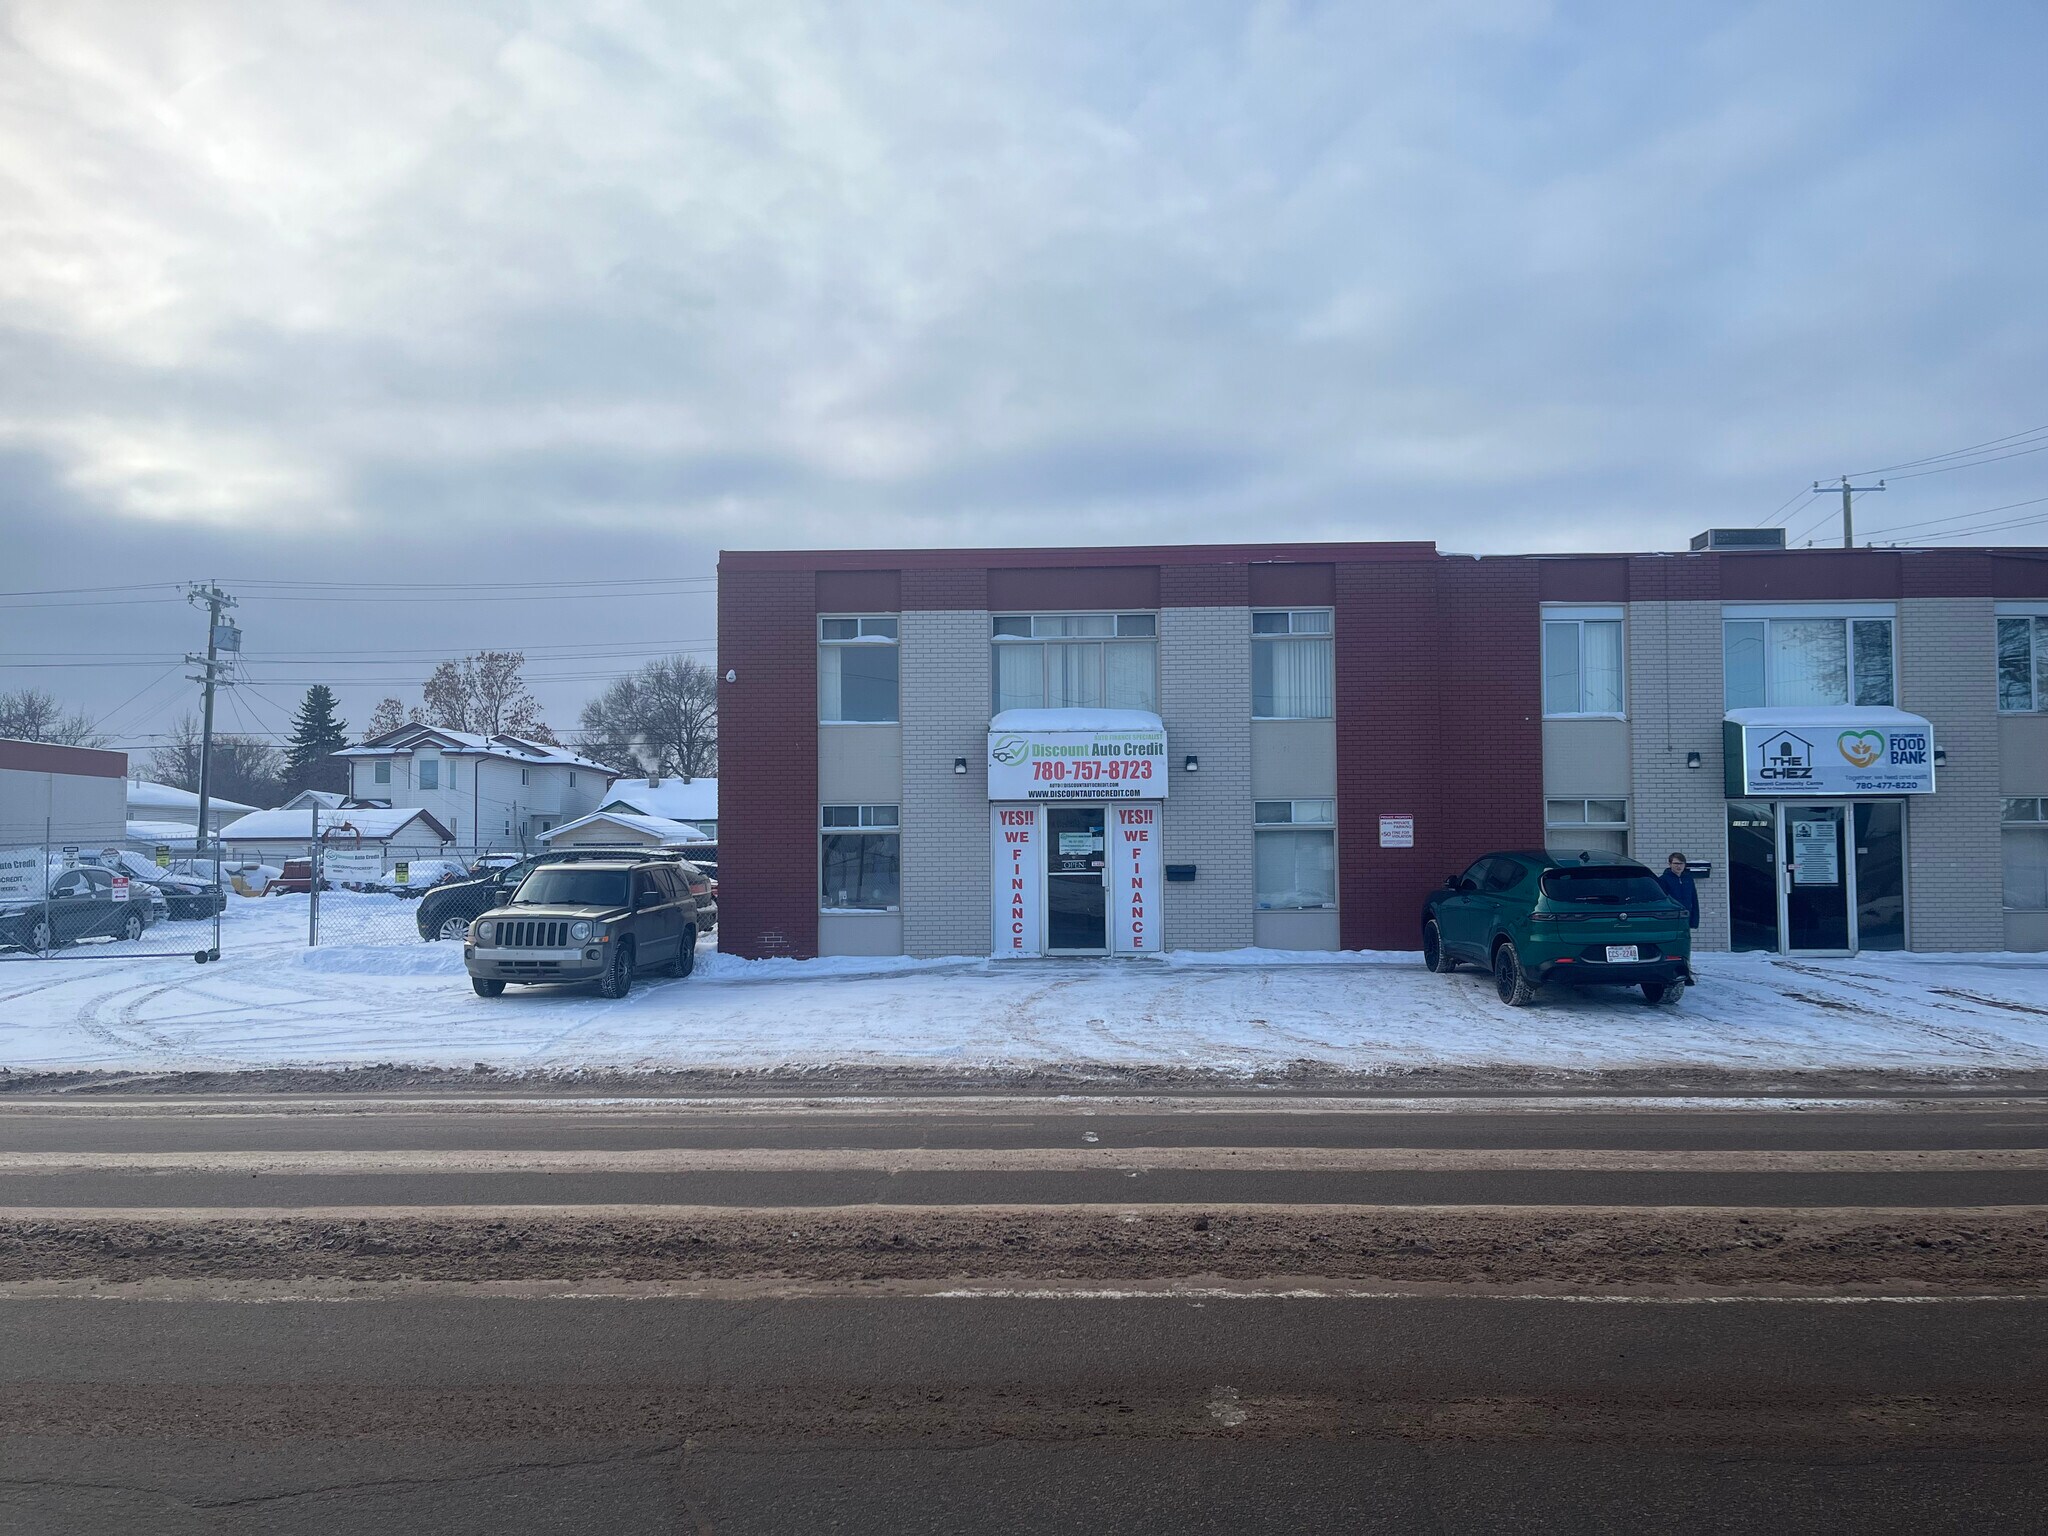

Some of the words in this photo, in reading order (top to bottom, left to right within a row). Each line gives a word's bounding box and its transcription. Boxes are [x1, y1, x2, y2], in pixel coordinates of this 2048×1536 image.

[1032, 744, 1089, 757] Discount
[1092, 743, 1120, 756] Auto
[1124, 742, 1163, 756] Credit
[1890, 738, 1925, 750] FOOD
[1770, 757, 1802, 766] THE
[1890, 751, 1926, 764] BANK
[1032, 760, 1152, 780] 780-757-8723
[1760, 767, 1813, 779] CHEZ
[1028, 789, 1140, 798] WWW.DISCOUNTAUTOCREDIT.COM
[1000, 811, 1034, 825] YES!!
[1119, 810, 1153, 824] YES!!
[1005, 832, 1029, 842] WE
[1124, 831, 1148, 841] WE
[0, 862, 12, 870] uto
[13, 860, 36, 869] Credit
[1012, 849, 1023, 948] FINANCE
[1132, 848, 1143, 948] FINANCE
